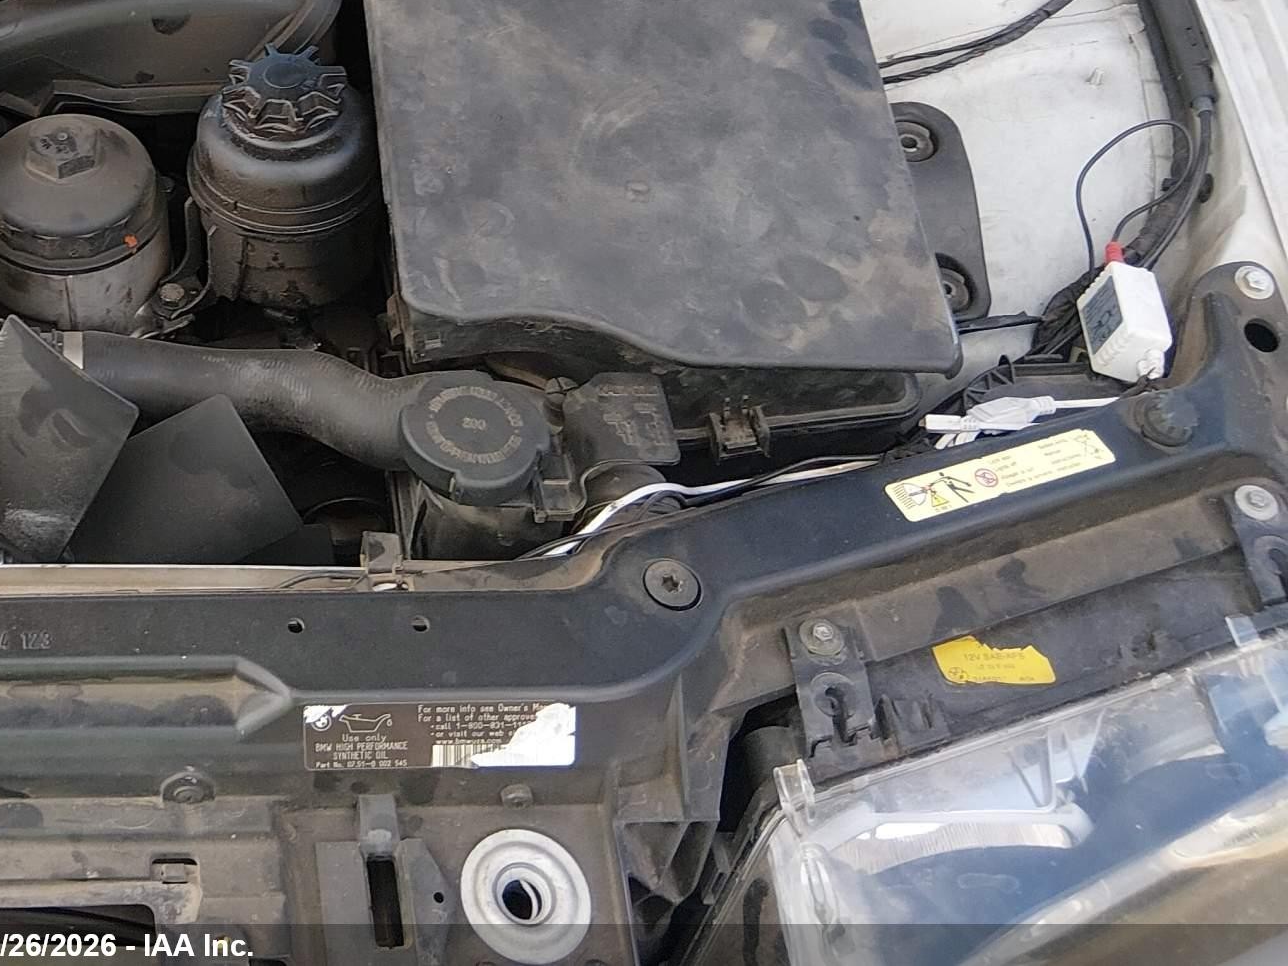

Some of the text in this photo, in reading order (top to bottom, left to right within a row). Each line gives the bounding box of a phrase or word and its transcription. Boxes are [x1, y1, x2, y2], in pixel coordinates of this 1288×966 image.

[417, 705, 432, 713] For
[459, 704, 476, 713] info
[498, 703, 528, 712] Owner's
[417, 714, 432, 722] For
[445, 713, 460, 721] list
[464, 713, 474, 721] of
[478, 713, 499, 721] other
[503, 714, 536, 722] approve
[342, 733, 387, 743] Use only
[448, 730, 467, 738] visit
[489, 729, 504, 737] web
[315, 740, 408, 752] BMW HIGH PERFORMANCE
[333, 750, 389, 760] SYNTHETIC OIL
[315, 761, 330, 769] Part
